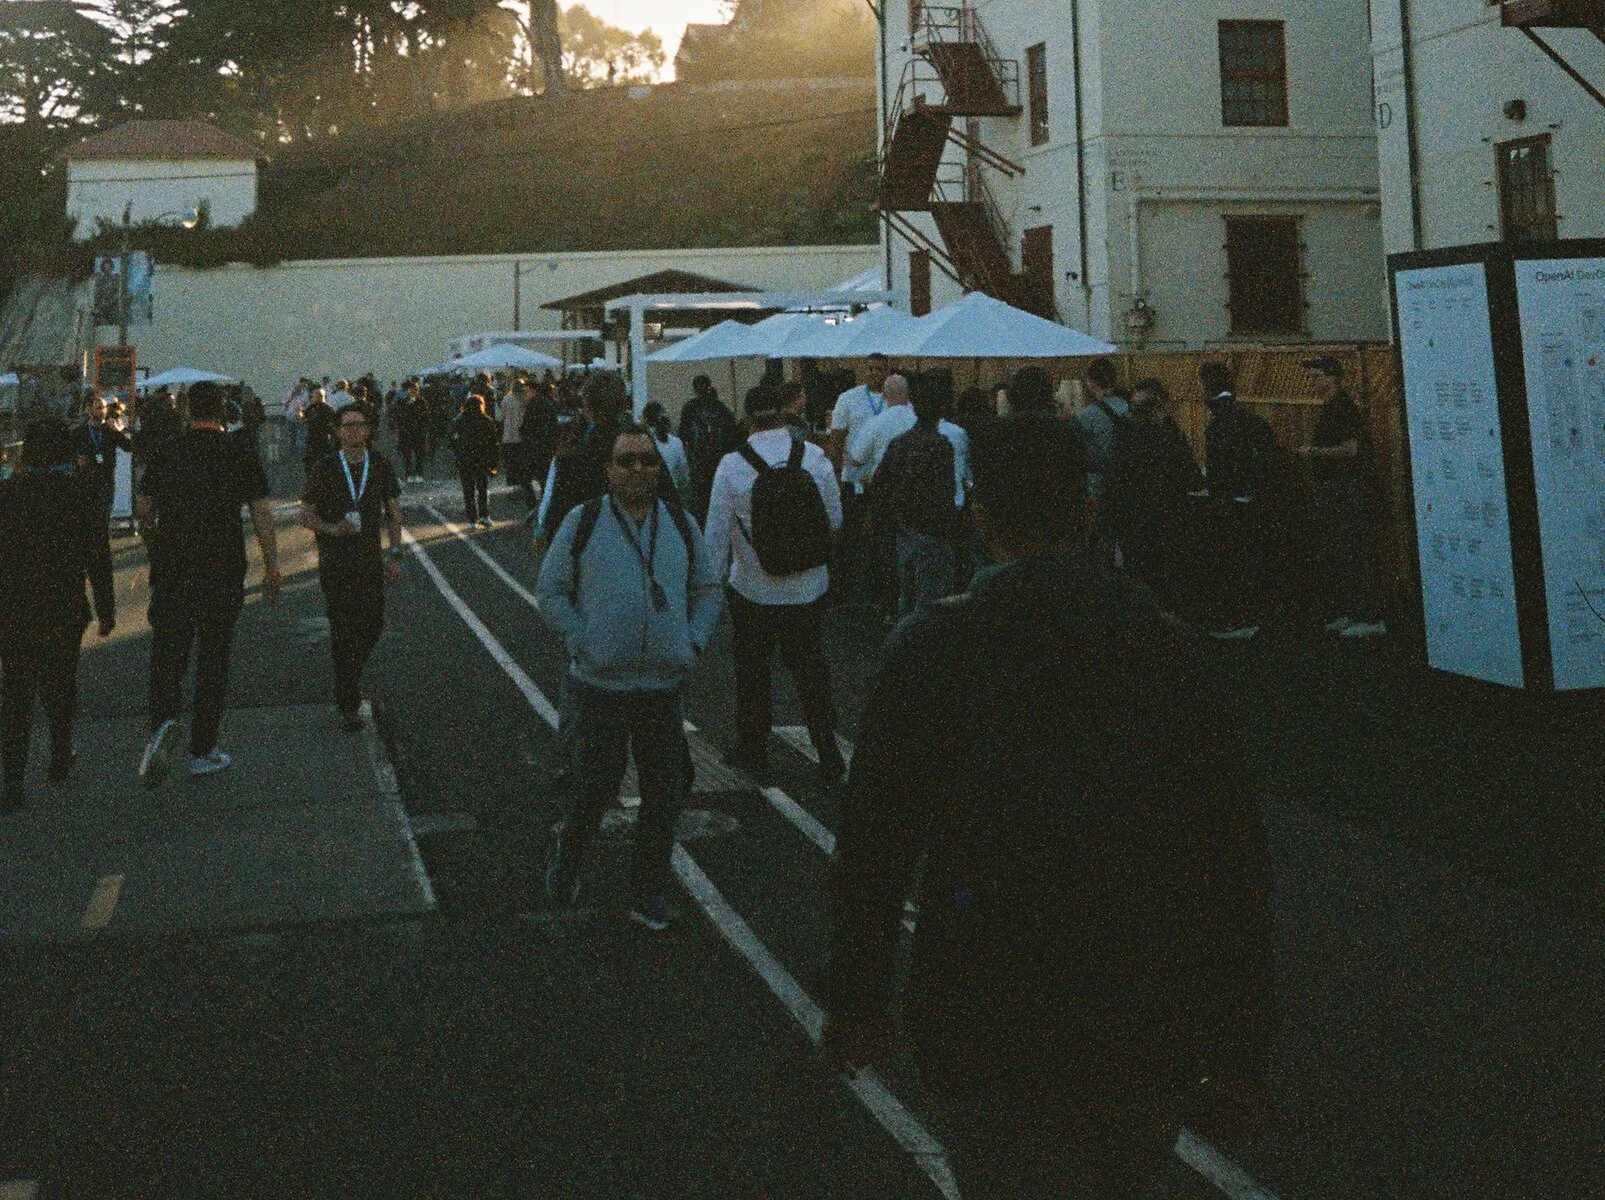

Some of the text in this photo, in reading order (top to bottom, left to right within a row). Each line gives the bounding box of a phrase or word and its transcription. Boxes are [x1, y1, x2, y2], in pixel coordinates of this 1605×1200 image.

[1378, 102, 1392, 129] D
[1111, 171, 1127, 192] E
[1535, 270, 1574, 283] OpenAI
